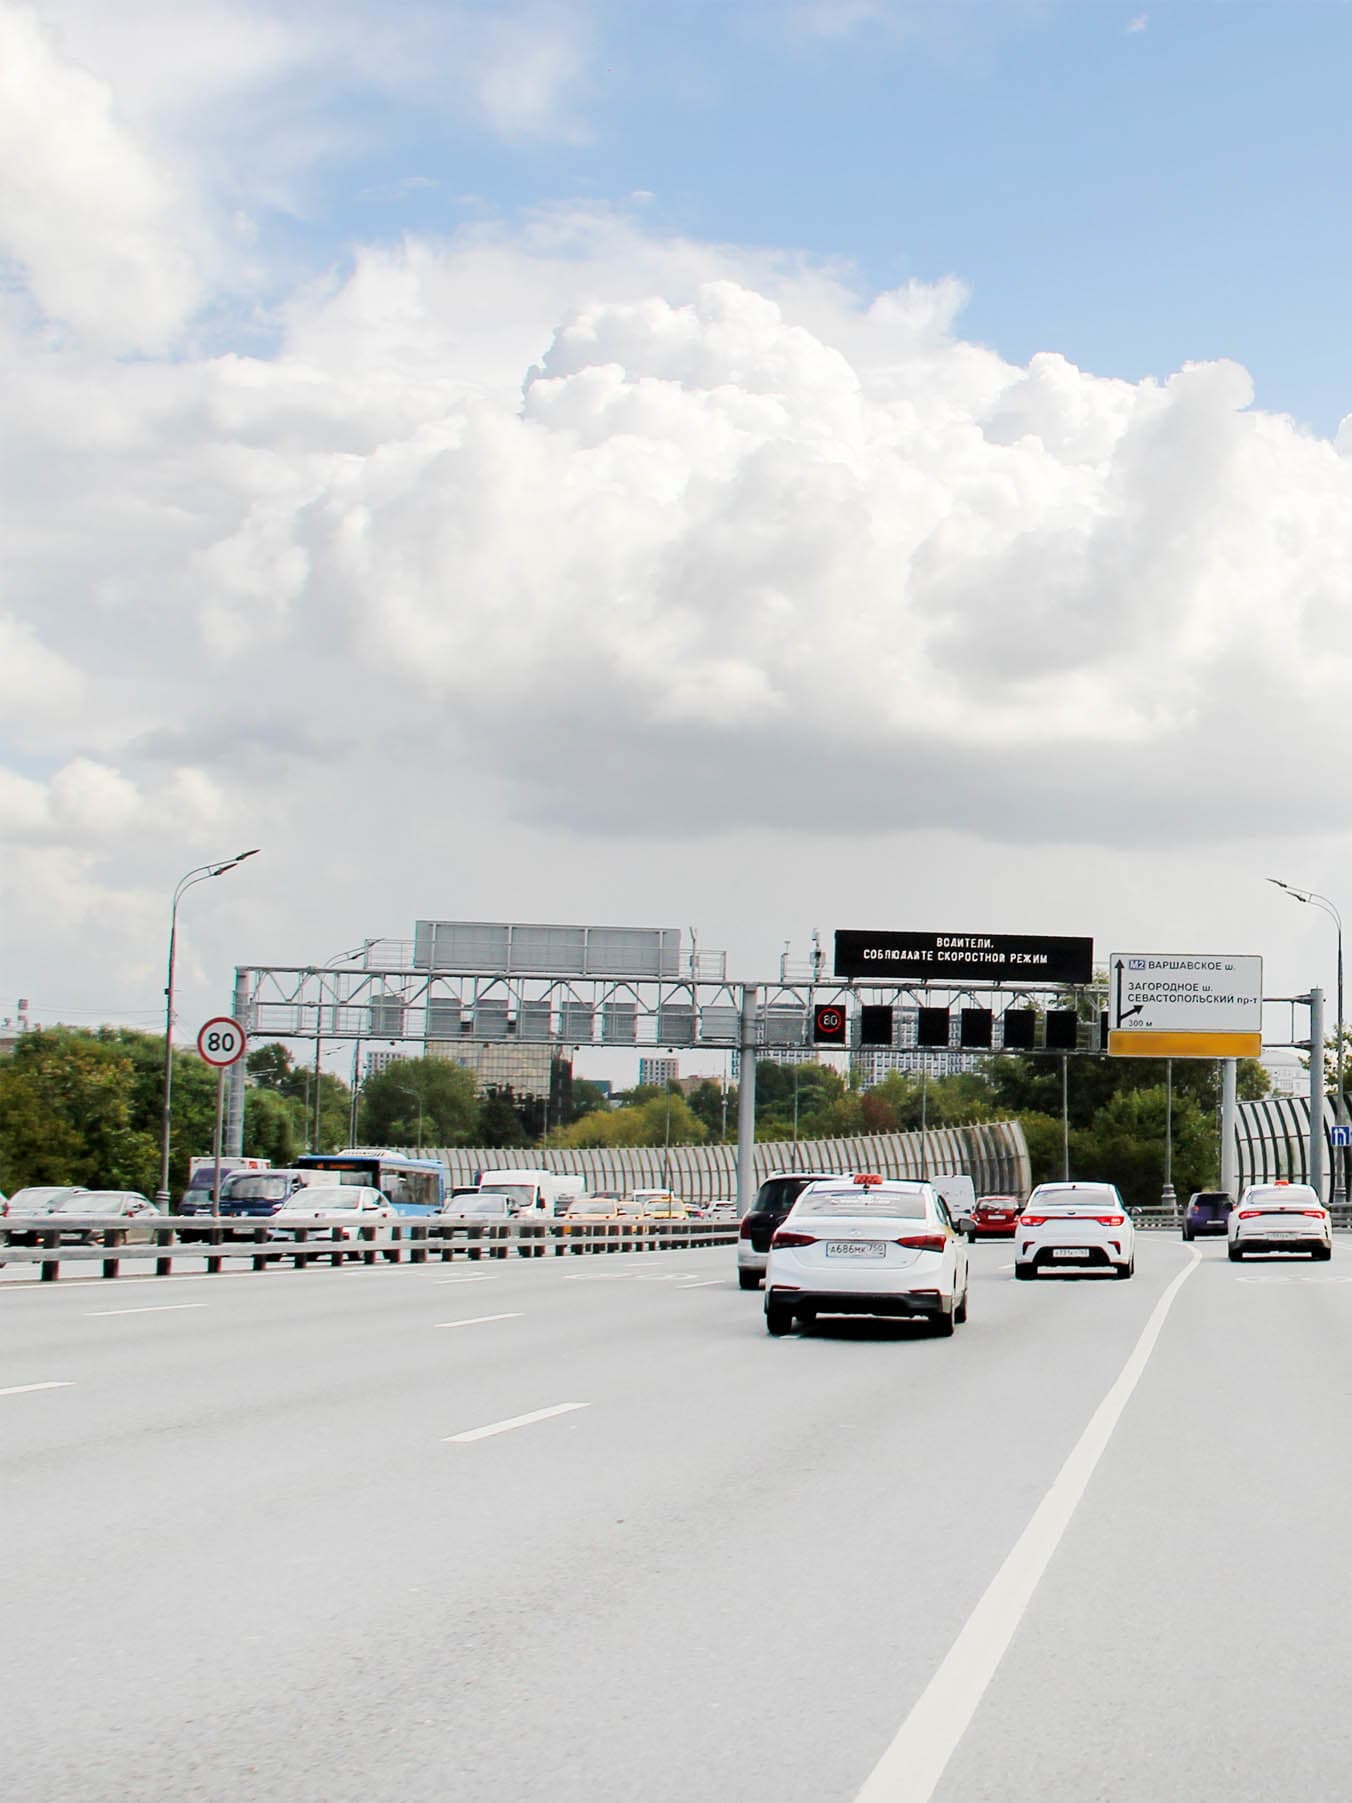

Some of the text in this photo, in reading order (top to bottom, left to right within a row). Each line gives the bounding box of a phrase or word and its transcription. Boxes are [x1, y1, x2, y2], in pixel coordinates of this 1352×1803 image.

[863, 949, 1048, 964] СОБЛЮДАЙТЕ СКОРОСТНОЙ РЕЖИМ
[1148, 961, 1222, 971] ВАРШАВСКОЕ
[1128, 982, 1199, 992] ЗАГОРОДНОЕ
[1127, 993, 1235, 1004] СЕВАСТОПОЛЬСКИЙ
[823, 1014, 838, 1026] 80
[208, 1032, 234, 1052] 80
